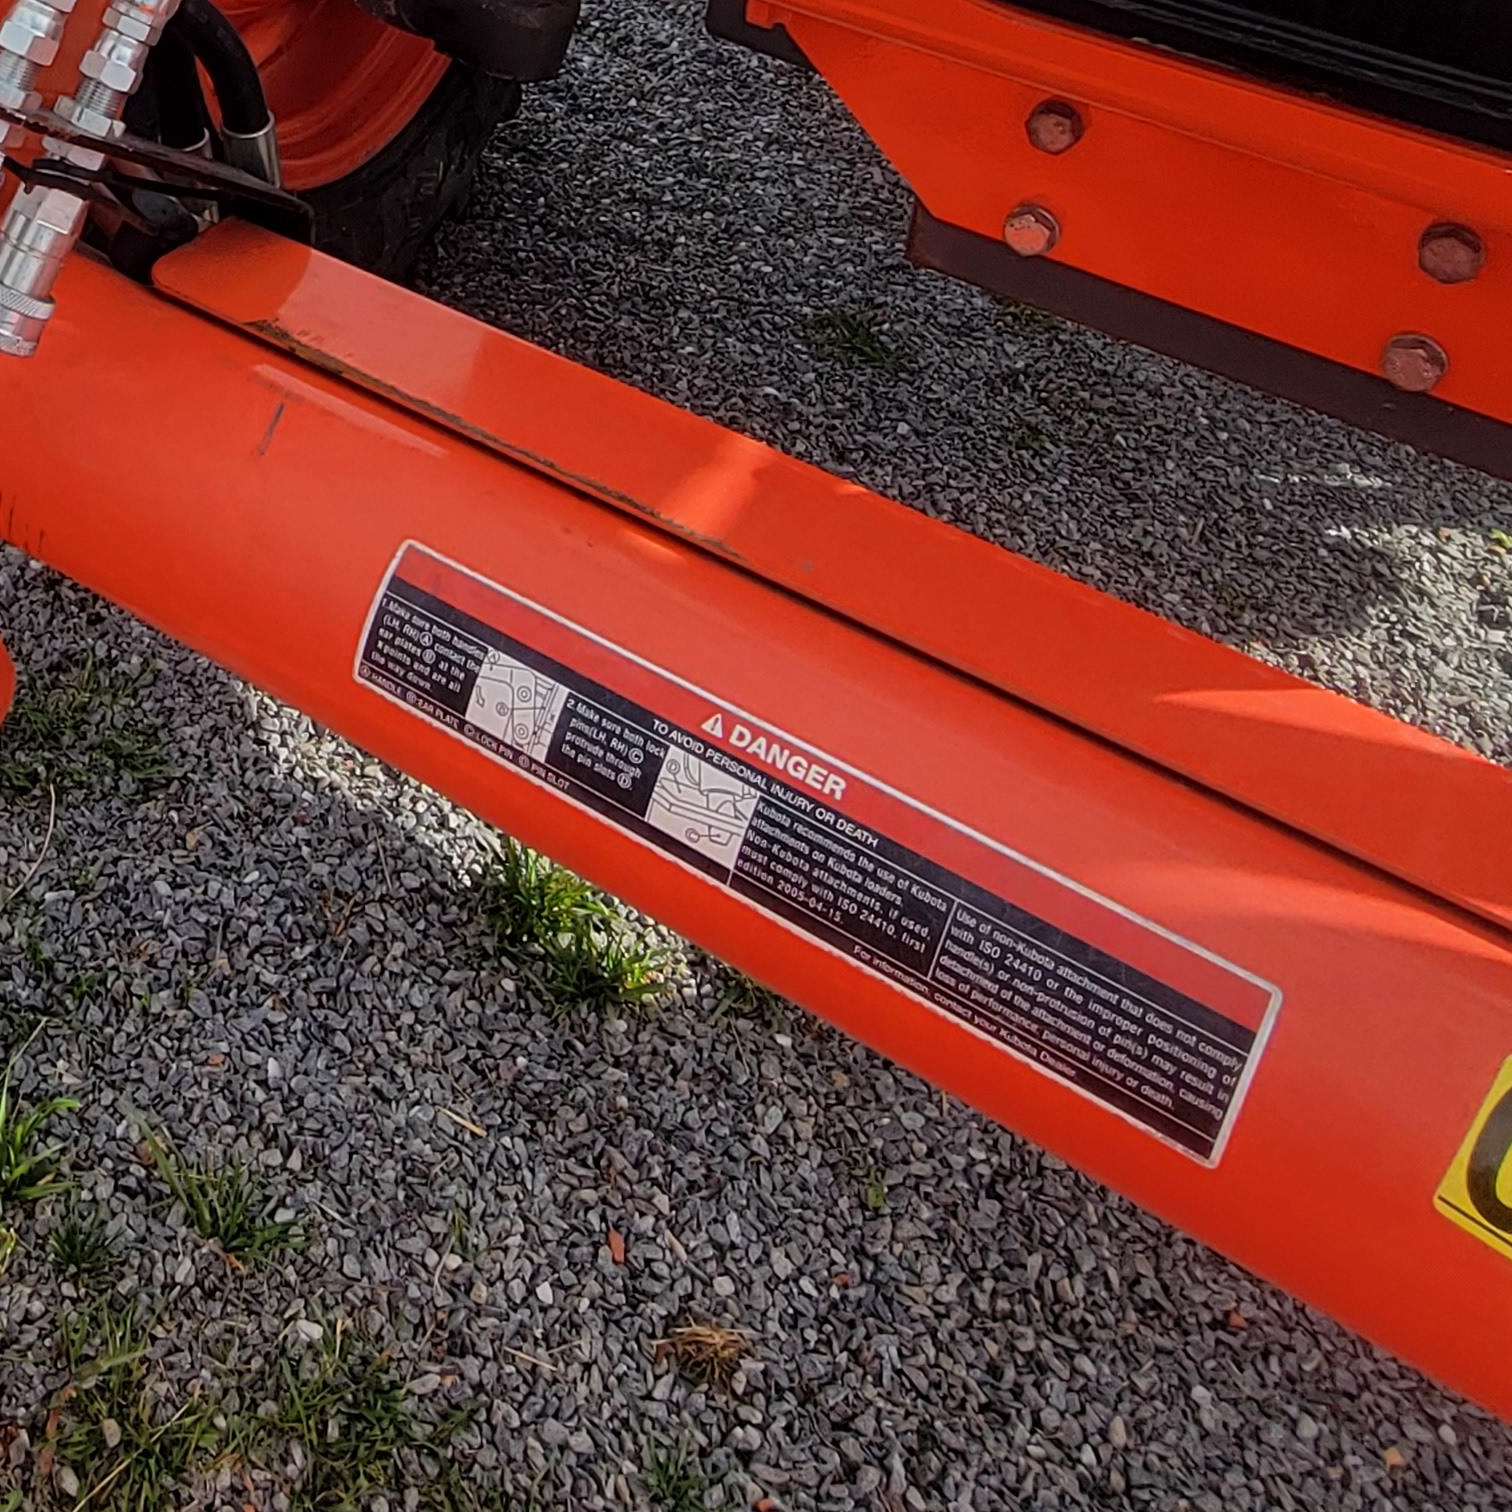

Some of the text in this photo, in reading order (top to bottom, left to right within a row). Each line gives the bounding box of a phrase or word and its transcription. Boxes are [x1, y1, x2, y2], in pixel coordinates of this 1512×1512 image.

[387, 600, 410, 619] Make
[411, 615, 430, 630] sure
[431, 624, 451, 641] both
[451, 635, 484, 660] handles
[561, 743, 575, 758] the
[576, 753, 591, 767] pin
[593, 762, 615, 780] slots
[564, 731, 641, 778] protrude through
[575, 702, 599, 722] Make
[601, 718, 621, 734] sure
[622, 727, 644, 746] both
[645, 739, 665, 758] lock
[609, 737, 628, 756] RH)
[728, 723, 846, 800] DANGER
[653, 718, 878, 847] TO AVOID PERSONAL INJURY OR DEATH
[736, 858, 773, 884] edition
[741, 845, 768, 865] must
[769, 860, 808, 889] comply
[811, 883, 833, 902] with
[837, 895, 857, 914] ISO
[901, 932, 925, 953] first
[746, 828, 809, 871] Non-Kubota
[888, 907, 898, 919] if
[750, 816, 902, 906] attachments on Kubota loaders.
[756, 800, 947, 911] Kubota recommends the use of Kubota
[853, 944, 871, 960] For
[933, 992, 972, 1018] contact
[973, 1014, 997, 1032] your
[998, 1027, 1037, 1057] Kubota
[934, 966, 956, 986] loss
[958, 982, 970, 993] of
[1041, 1029, 1090, 1061] personal
[1091, 1054, 1124, 1080] injury
[1125, 1076, 1139, 1087] or
[944, 938, 1229, 1103] handle(s) or non-protrusion of pin(s) may result in
[950, 925, 1237, 1086] with ISO 24410 or the improper positioning of
[956, 908, 1242, 1072] Use of non-Kubota attachment that does not comply
[999, 989, 1013, 1000] of
[1013, 994, 1030, 1011] the
[1030, 1006, 1091, 1045] attachment
[1092, 1040, 1105, 1051] or
[1178, 1088, 1223, 1120] causing
